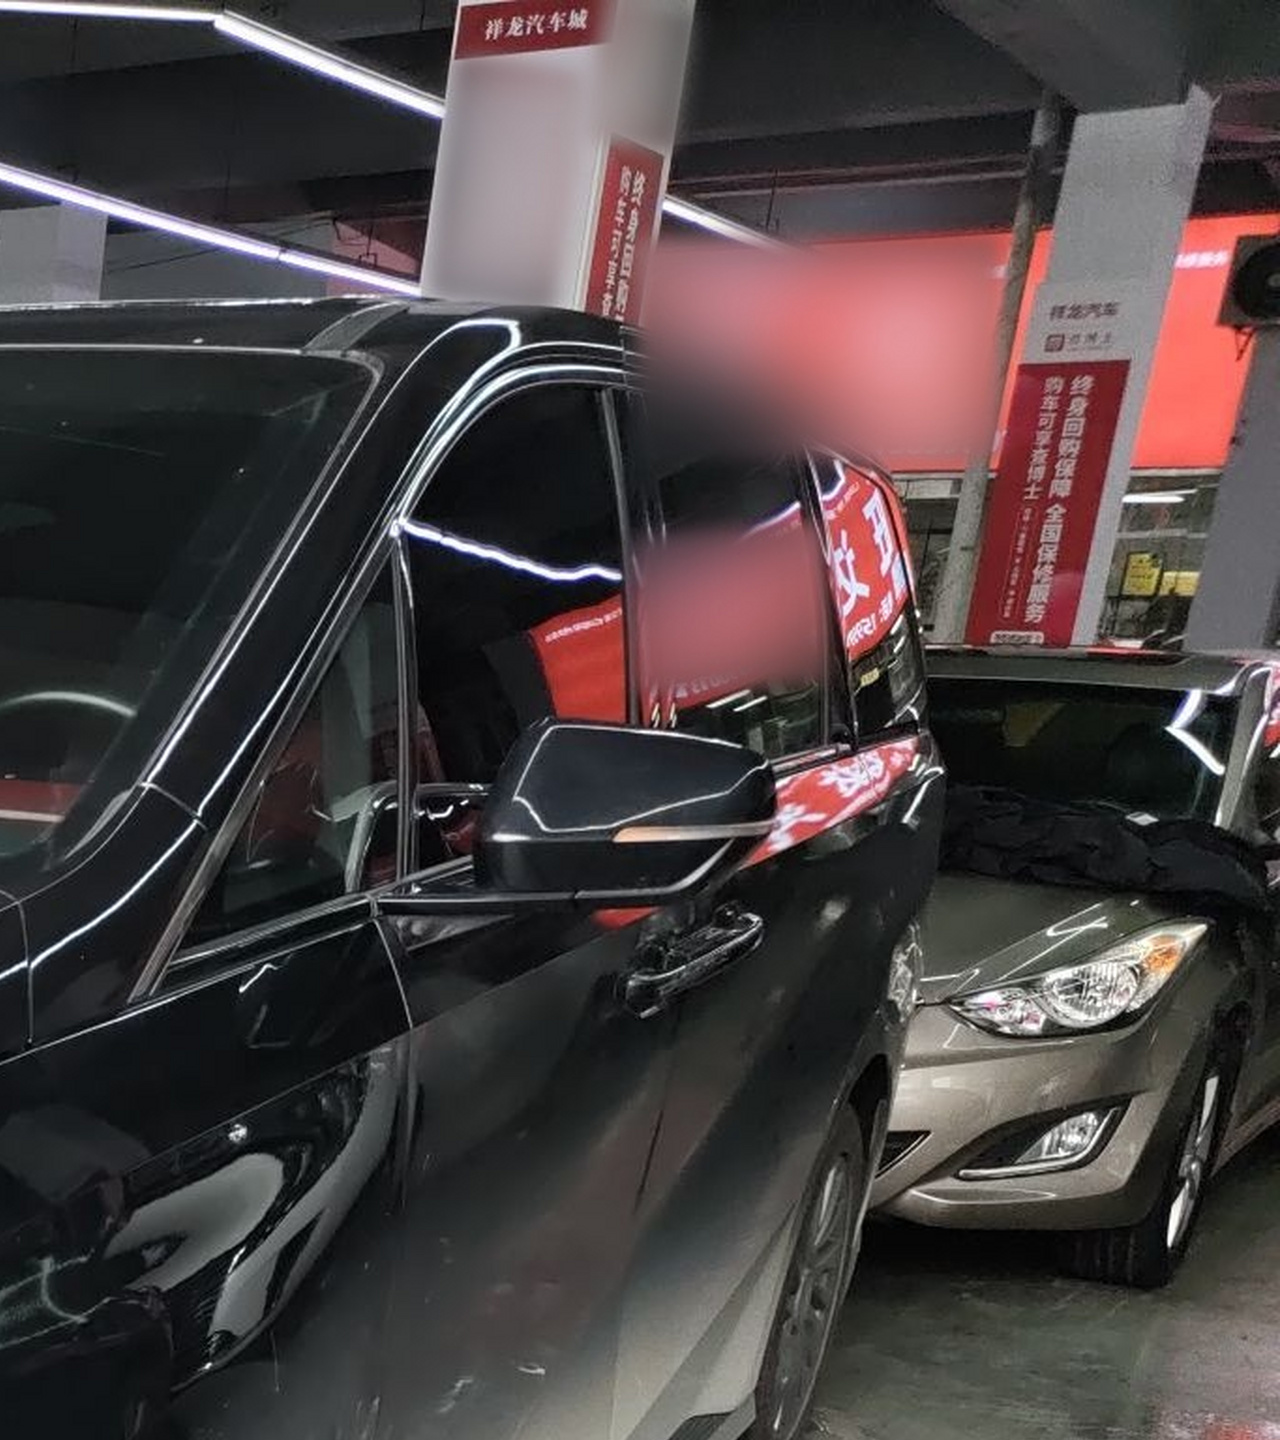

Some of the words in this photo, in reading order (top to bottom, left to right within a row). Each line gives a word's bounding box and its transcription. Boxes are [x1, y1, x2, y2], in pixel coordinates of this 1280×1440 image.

[485, 9, 589, 41] 祥龙汽车城
[1049, 302, 1121, 321] 祥龙汽车
